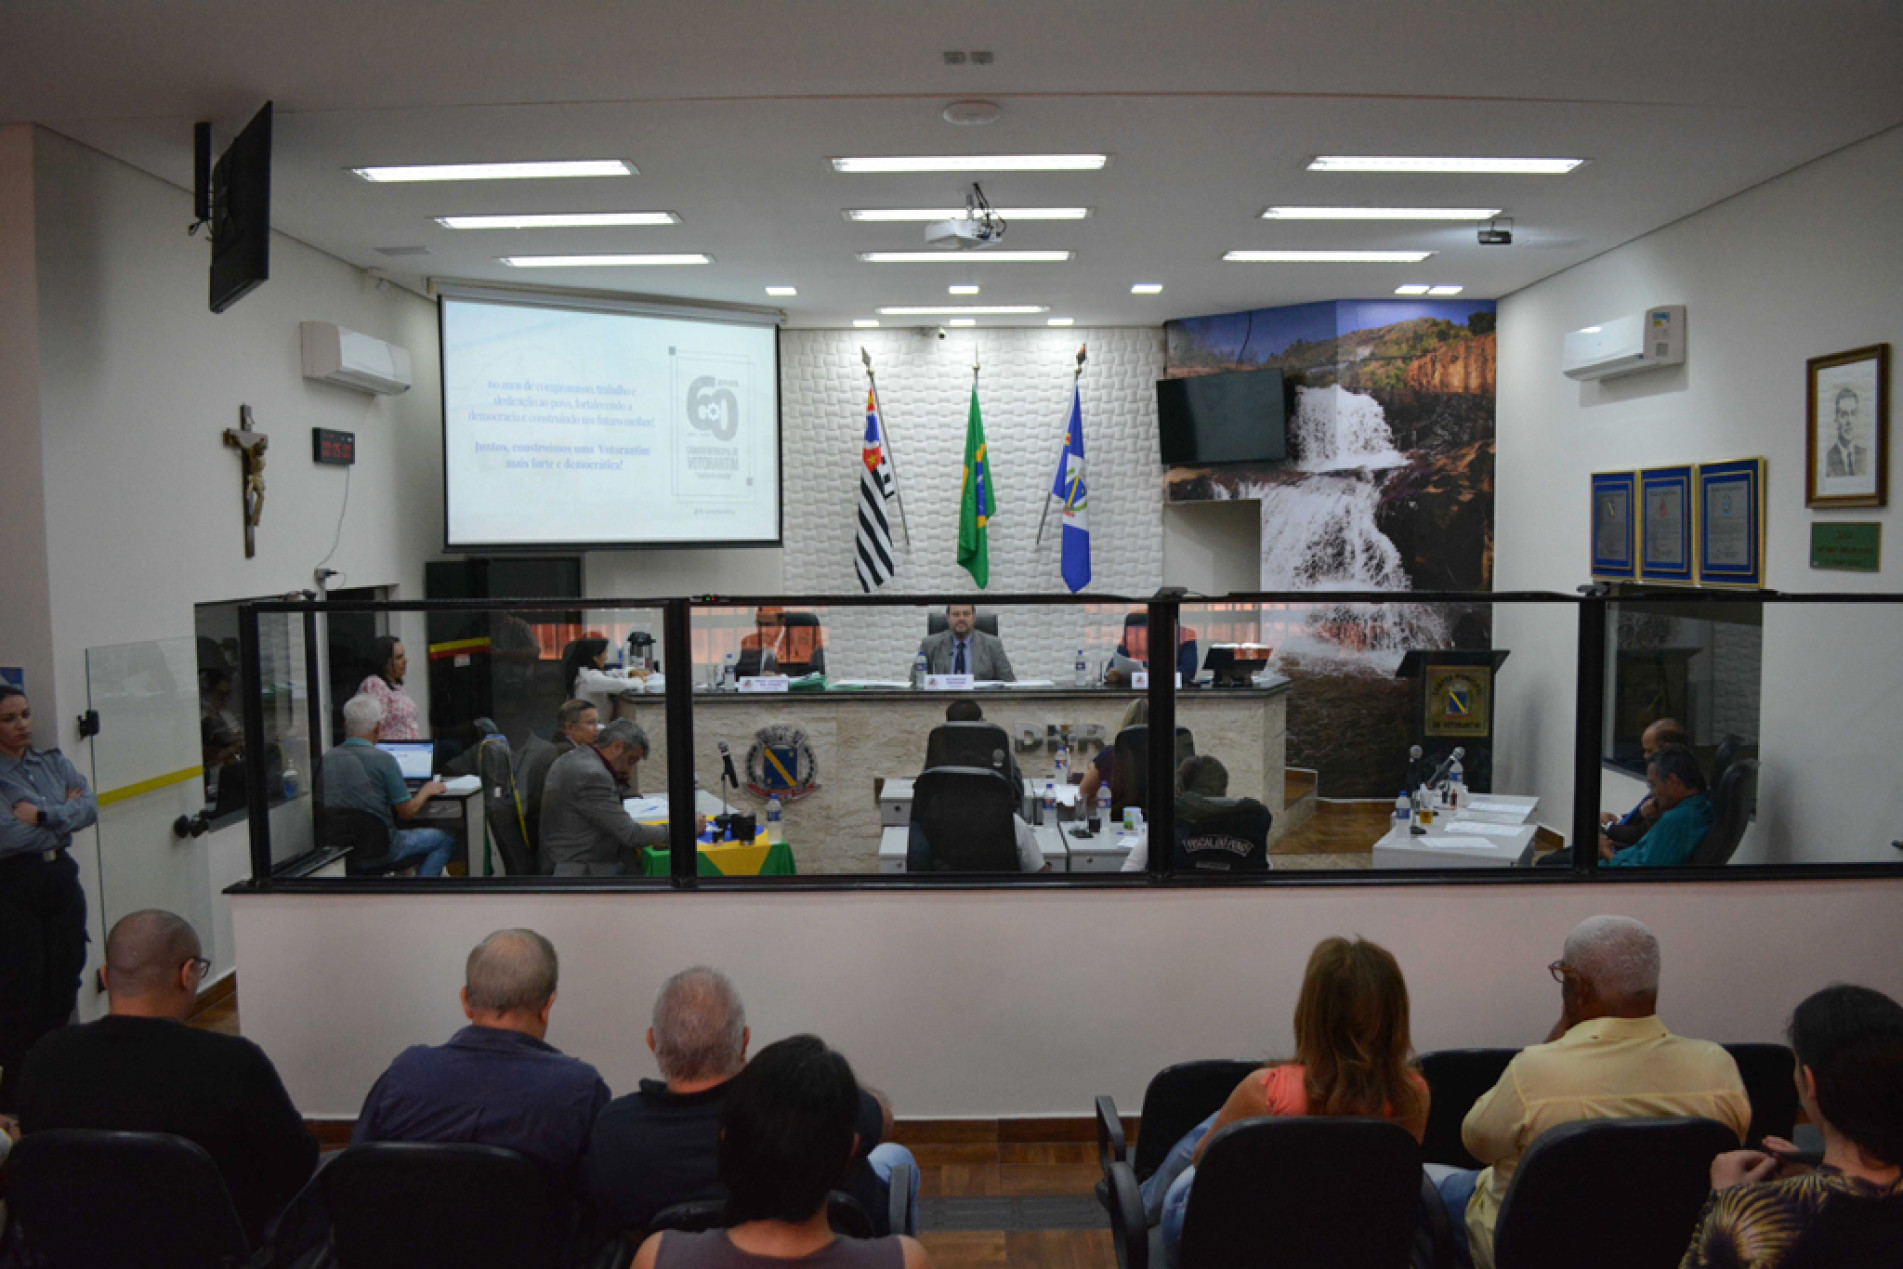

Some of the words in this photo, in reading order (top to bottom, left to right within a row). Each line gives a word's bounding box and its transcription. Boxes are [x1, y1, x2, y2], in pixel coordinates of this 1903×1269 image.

[524, 380, 533, 391] de
[686, 375, 739, 442] 60
[531, 457, 554, 469] forte
